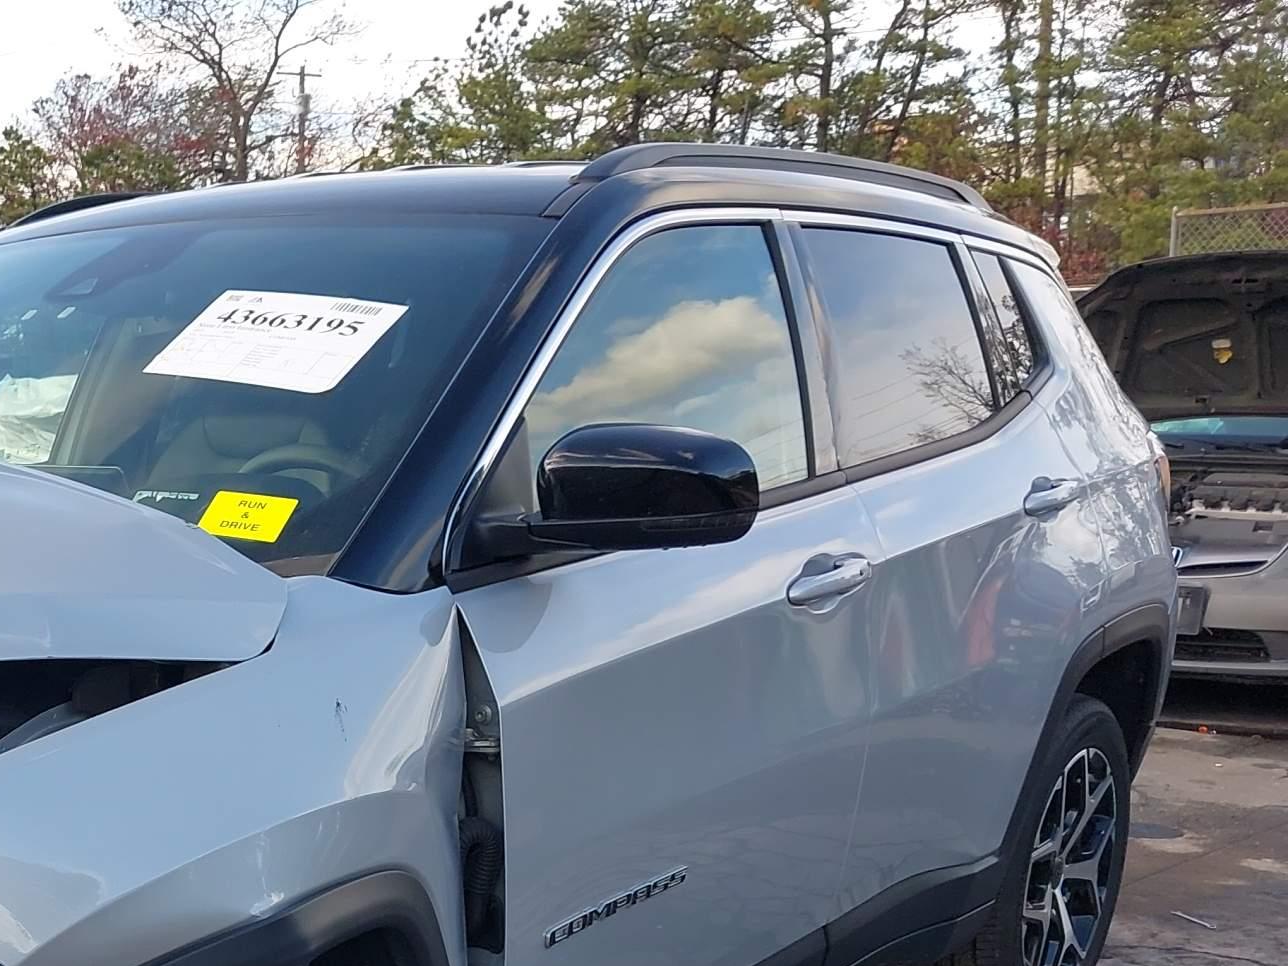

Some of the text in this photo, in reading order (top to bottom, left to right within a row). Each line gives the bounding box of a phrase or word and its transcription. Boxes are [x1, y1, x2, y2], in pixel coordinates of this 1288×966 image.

[217, 308, 365, 336] 43663195
[238, 500, 268, 510] RUN
[219, 520, 261, 531] DRIVE
[543, 864, 689, 949] COMPASS
